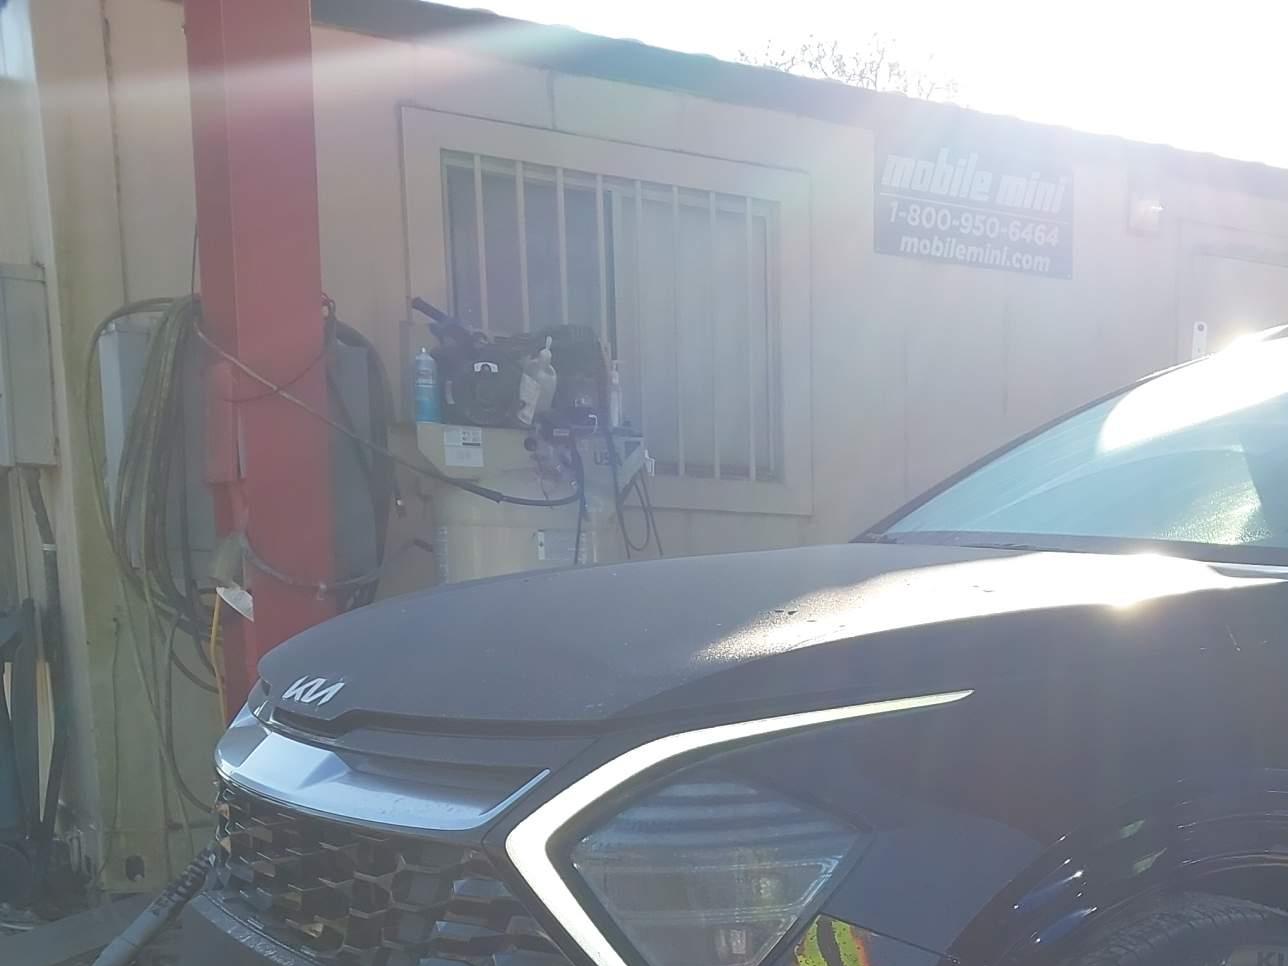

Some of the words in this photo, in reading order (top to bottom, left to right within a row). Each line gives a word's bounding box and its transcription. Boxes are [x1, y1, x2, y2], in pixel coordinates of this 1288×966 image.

[881, 147, 992, 201] mobile
[995, 171, 1067, 213] mini
[889, 201, 1060, 246] 1-800-950-6464
[899, 236, 1051, 273] mobilemini.com
